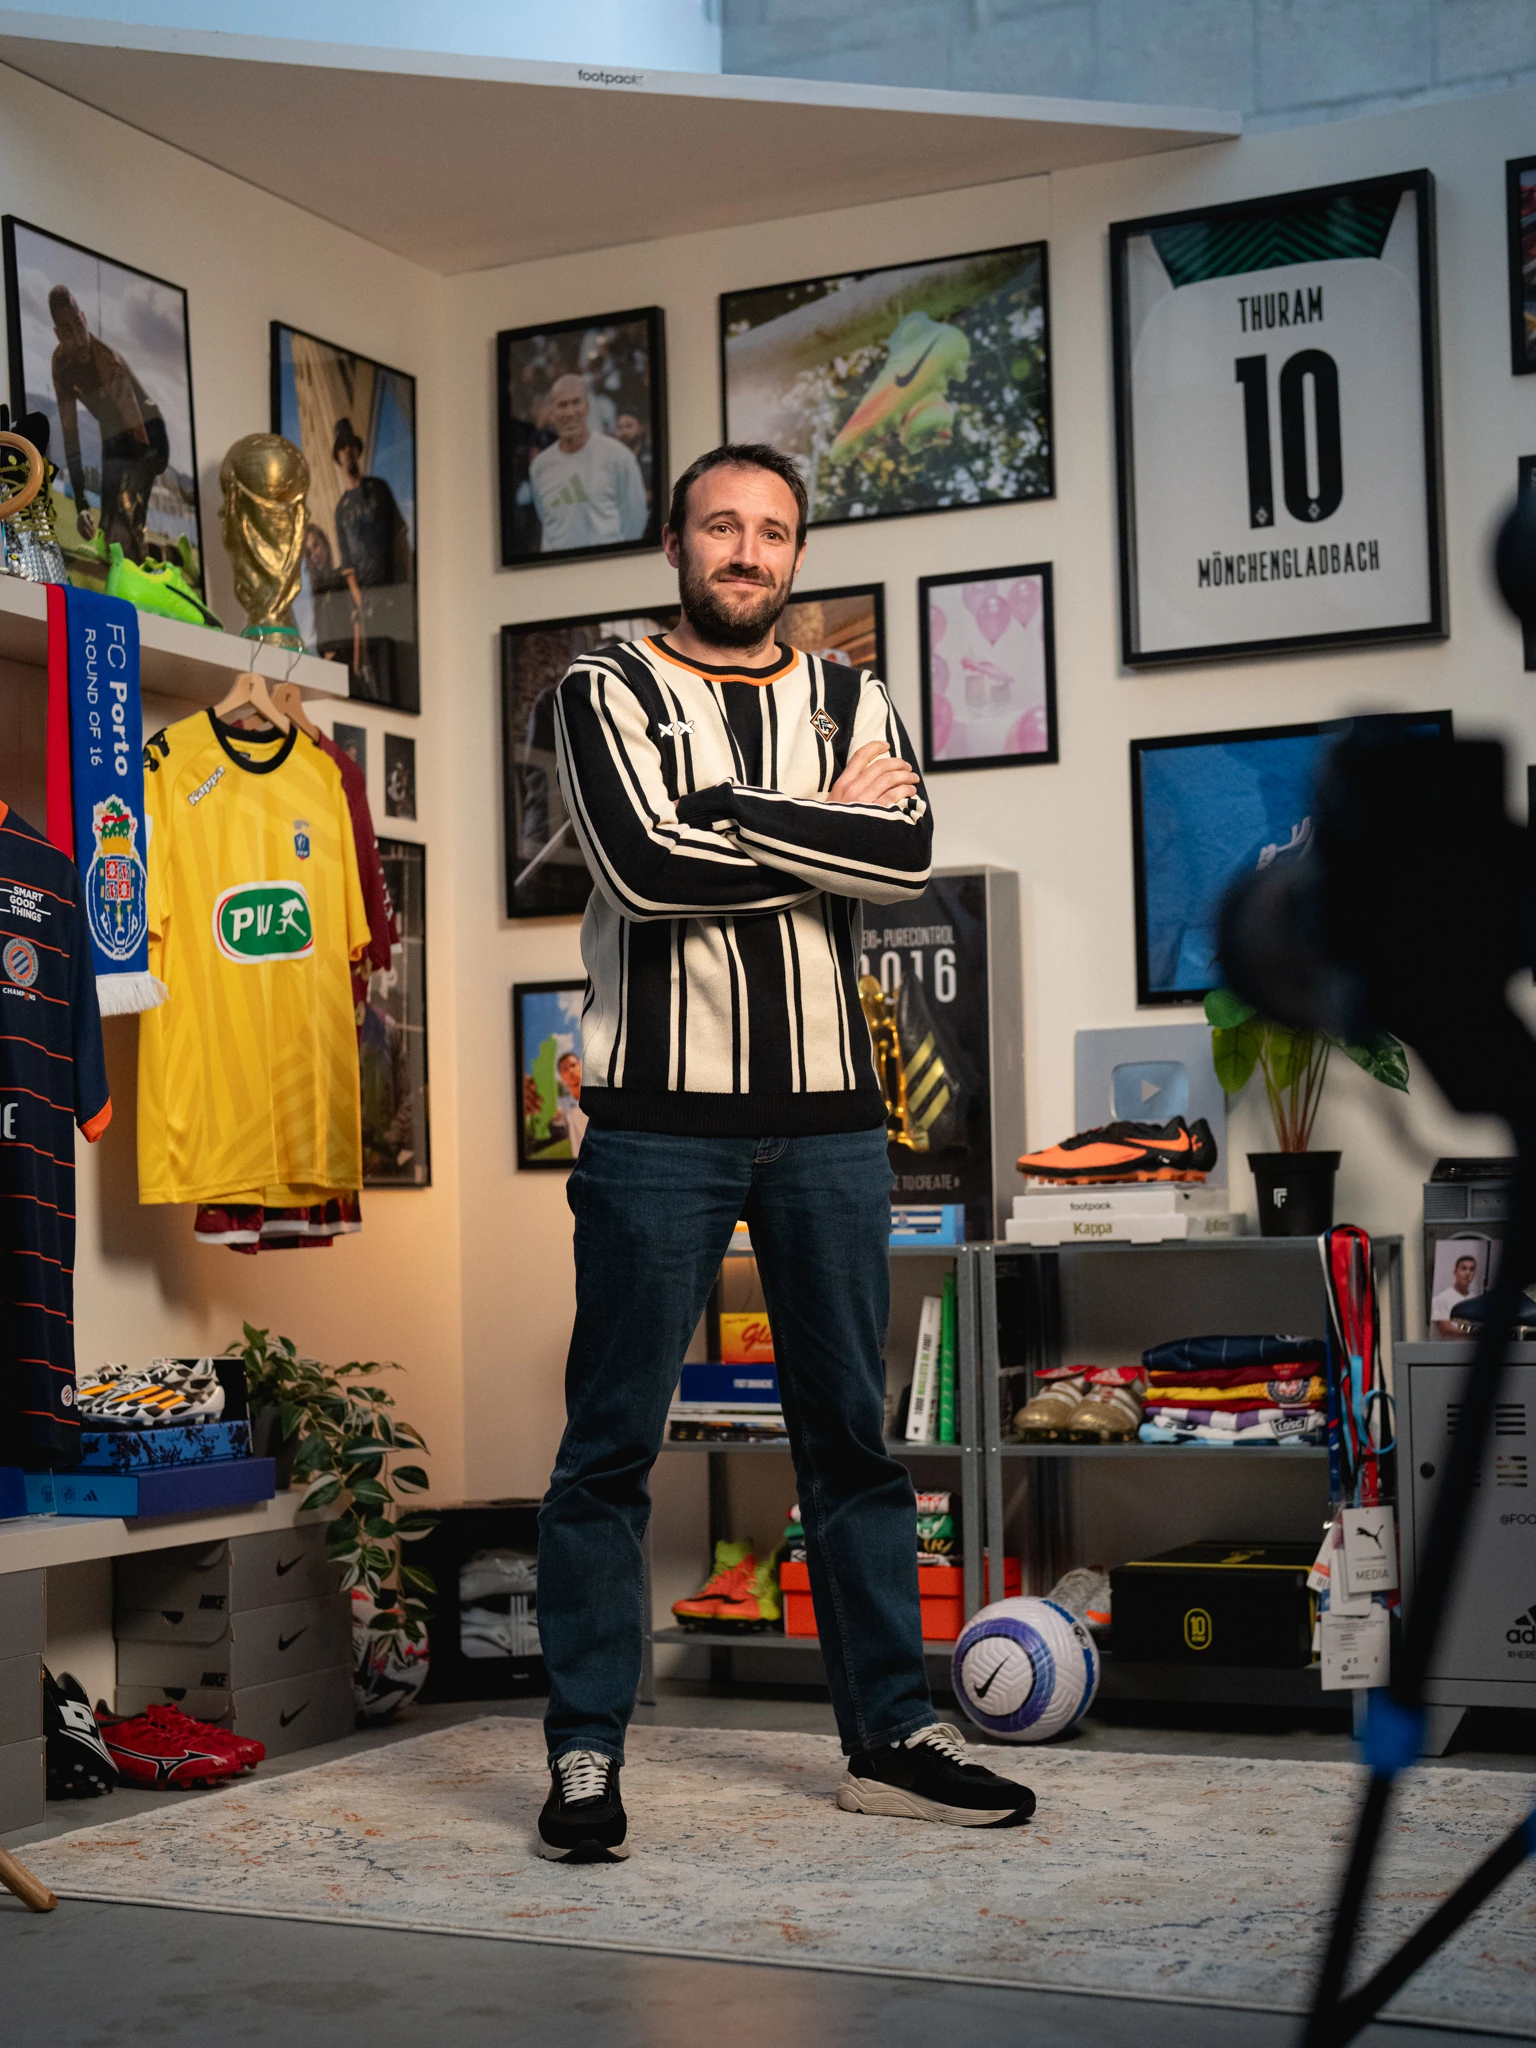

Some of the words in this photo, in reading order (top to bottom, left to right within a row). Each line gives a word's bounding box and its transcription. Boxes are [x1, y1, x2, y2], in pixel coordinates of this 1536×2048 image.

[1237, 286, 1323, 332] THURAM
[1234, 347, 1343, 529] 10
[1197, 539, 1380, 588] MÖNCHENGLADBACH
[106, 623, 126, 669] FC
[85, 628, 98, 704] ROUND
[89, 711, 101, 739] OF
[110, 681, 129, 776] Porto
[90, 747, 103, 766] 16
[188, 765, 225, 806] Kappa
[9, 895, 36, 910] GOOD
[13, 886, 44, 902] SMART
[11, 905, 42, 923] THINGS
[1073, 1222, 1112, 1237] Kappa
[1355, 1568, 1389, 1581] MEDIA
[198, 1594, 226, 1610] NIKE
[1190, 1616, 1206, 1636] 10
[200, 1672, 228, 1687] NIKE
